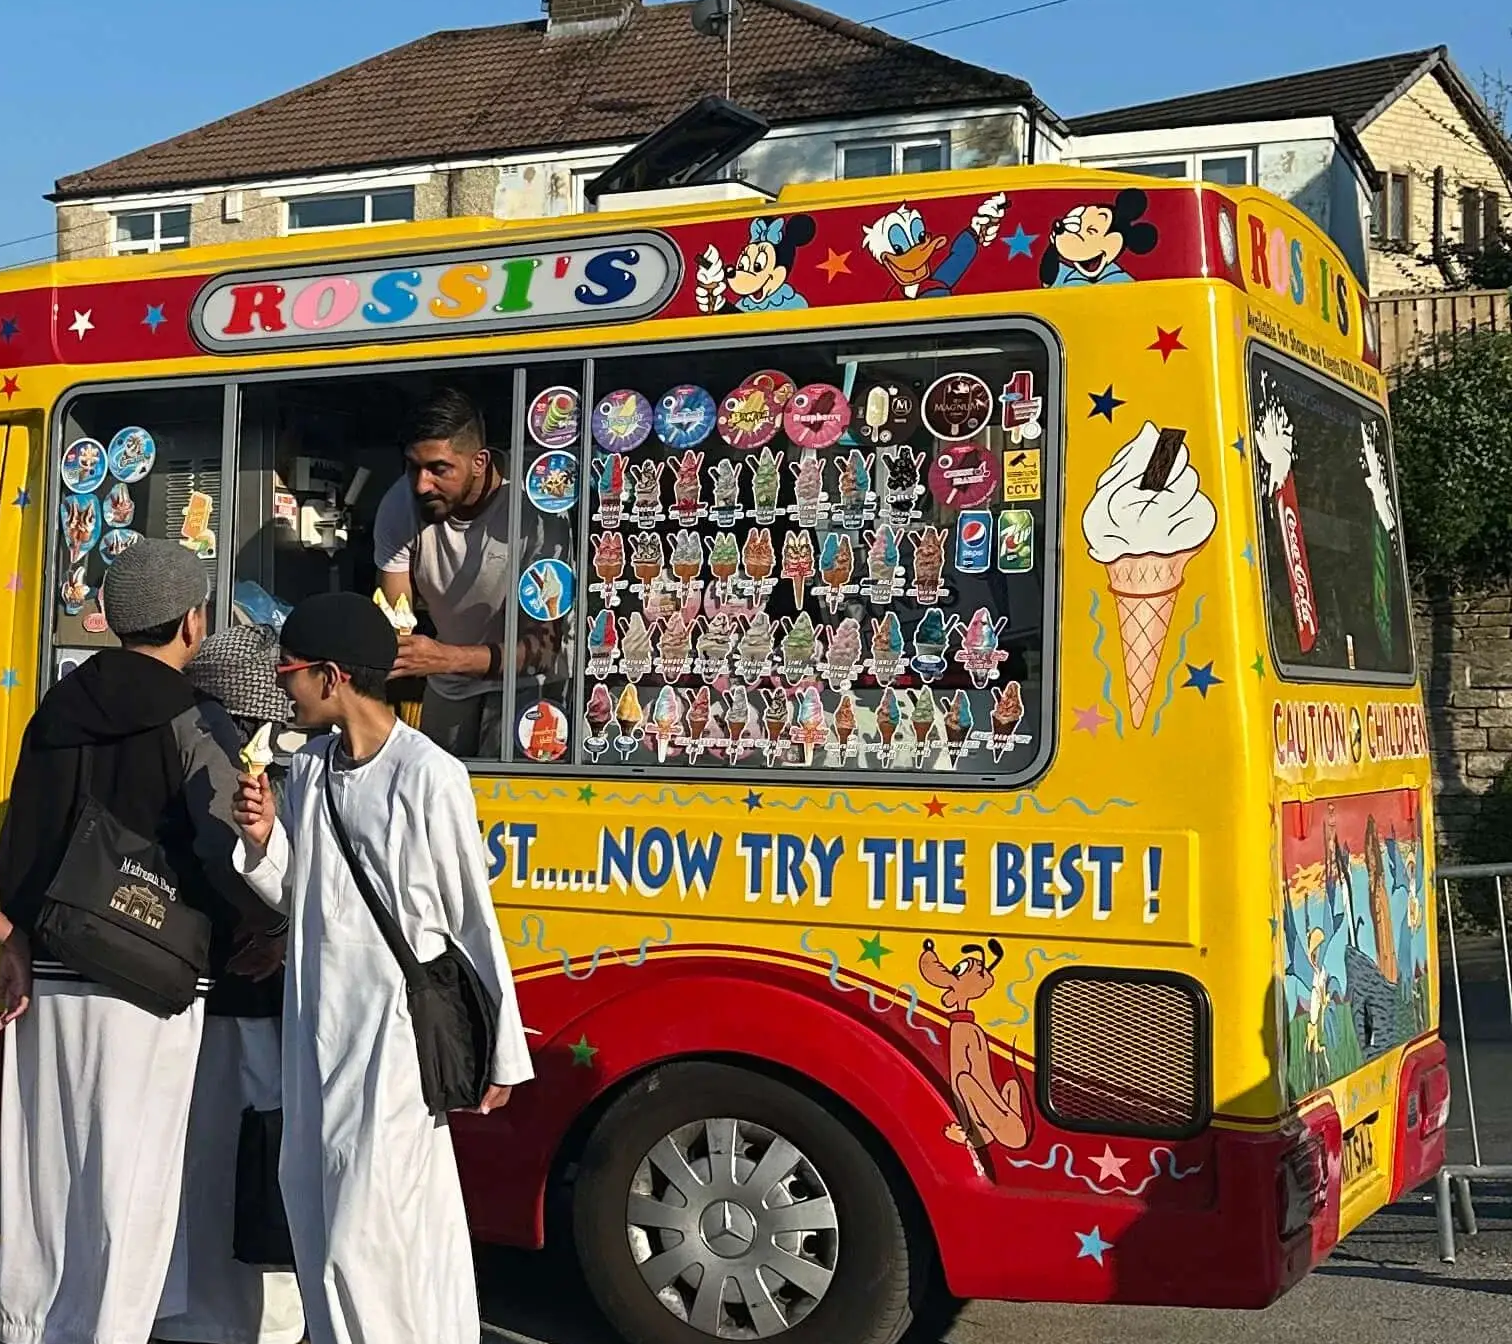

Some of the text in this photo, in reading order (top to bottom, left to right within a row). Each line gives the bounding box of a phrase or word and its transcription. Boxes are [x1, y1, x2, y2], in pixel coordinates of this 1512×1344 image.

[221, 248, 641, 335] ROSSI'S
[933, 402, 981, 412] MAGNUM
[1006, 484, 1039, 495] CCTV
[1273, 701, 1429, 766] CAUTION CHILDREN
[741, 831, 845, 907] TRY
[860, 836, 969, 914] THE
[992, 841, 1124, 921] BEST
